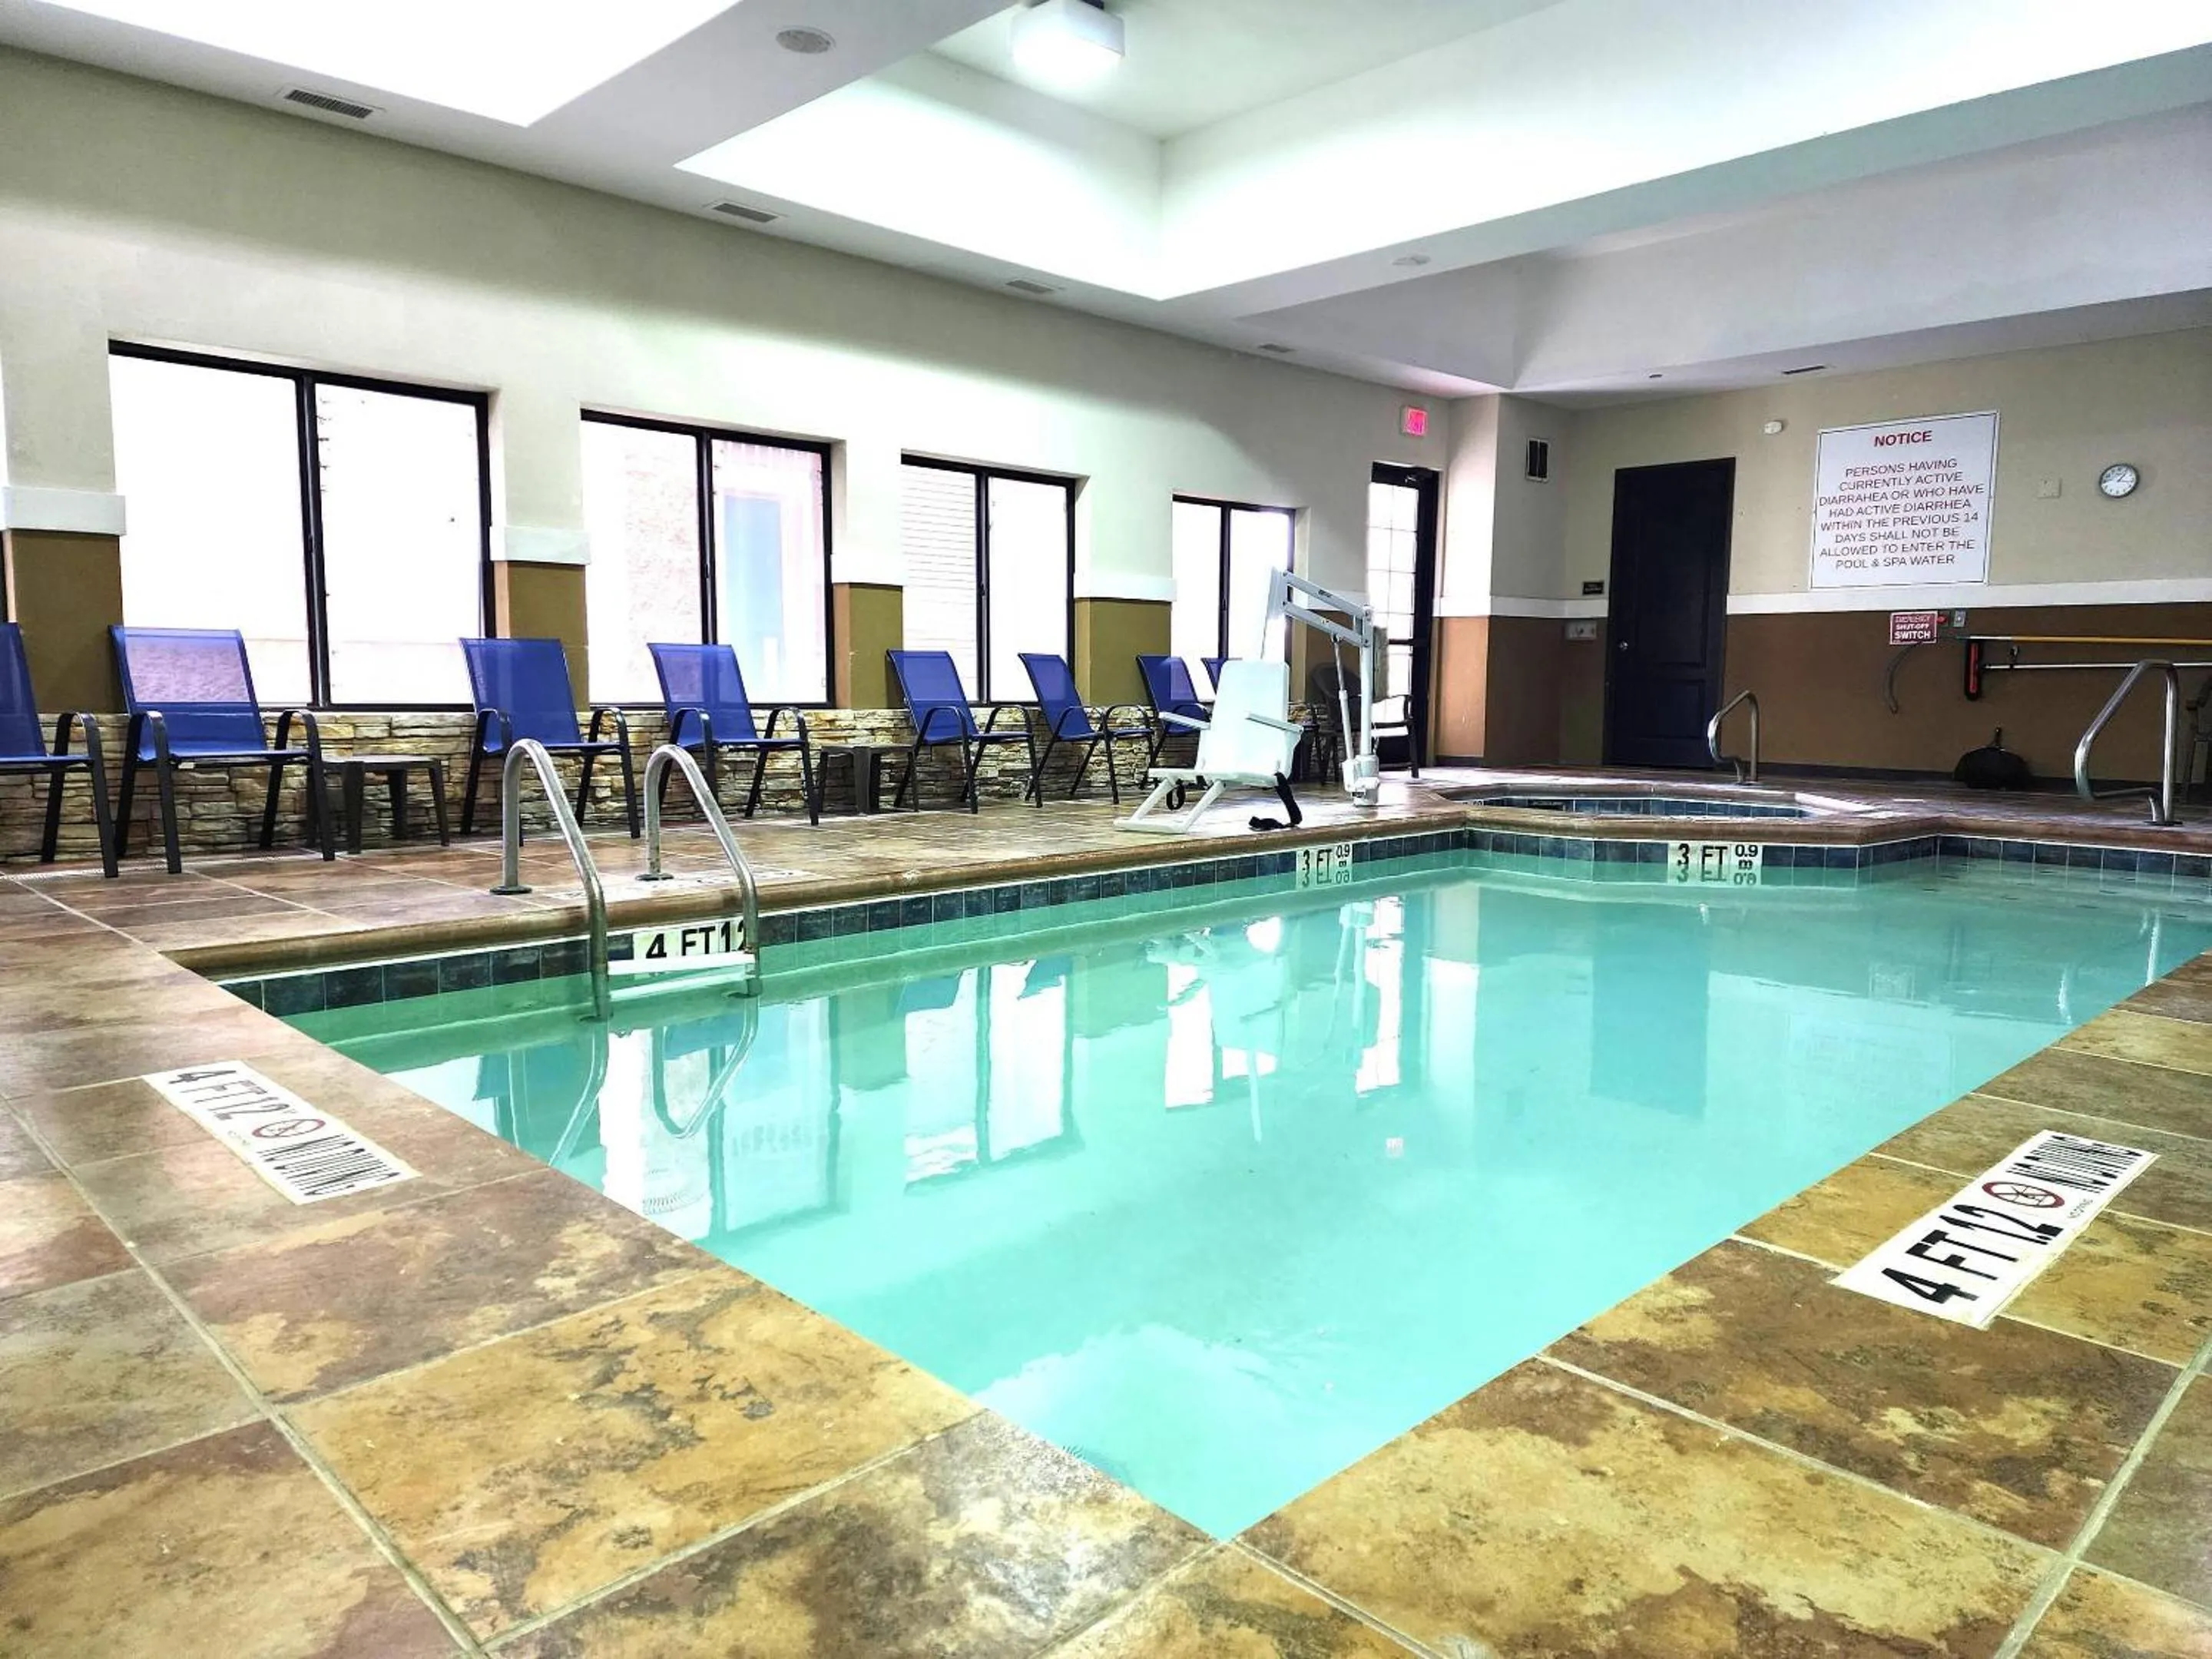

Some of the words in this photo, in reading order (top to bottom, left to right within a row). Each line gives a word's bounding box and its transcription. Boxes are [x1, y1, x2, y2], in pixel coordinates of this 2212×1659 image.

[1874, 430, 1932, 447] NOTICE
[1846, 462, 1905, 477] PERSONS
[1909, 459, 1958, 471] HAVING
[1839, 476, 1912, 492] CURRENTLY
[1915, 471, 1963, 485] ACTIVE
[1819, 492, 1888, 506] DIARRAHEA
[1891, 490, 1909, 501] OR
[1913, 487, 1945, 498] WHO
[1949, 483, 1985, 495] HAVE
[1829, 506, 1854, 518] HAD
[1856, 503, 1901, 515] ACTIVE
[1903, 498, 1972, 512] DIARRHEA
[1820, 520, 1862, 531] WITHIN
[1867, 518, 1889, 528] THE
[1892, 512, 1959, 527] PREVIOUS
[1964, 511, 1979, 522] 14
[1835, 532, 1866, 544] DAYS
[1869, 530, 1909, 541] SHALL
[1912, 528, 1939, 538] NOT
[1942, 526, 1960, 537] BE
[1820, 545, 1878, 557] ALLOWED
[1883, 543, 1898, 554] TO
[1902, 541, 1945, 552] ENTER
[1948, 539, 1975, 551] THE
[1836, 558, 1869, 569] POOL
[1870, 558, 1879, 568] &
[1883, 557, 1907, 567] SPA
[1909, 554, 1955, 565] WATER
[1894, 631, 1931, 640] SWITCH
[1336, 844, 1350, 859] 0.9
[1677, 843, 1690, 866] 3
[1701, 845, 1728, 866] FT
[1735, 844, 1758, 857] 0.9
[646, 933, 667, 959] 4
[681, 926, 716, 956] FT
[168, 1070, 237, 1084] 4
[180, 1080, 268, 1104] FT
[1905, 1230, 2019, 1280] FT
[1881, 1268, 1979, 1304] 4
